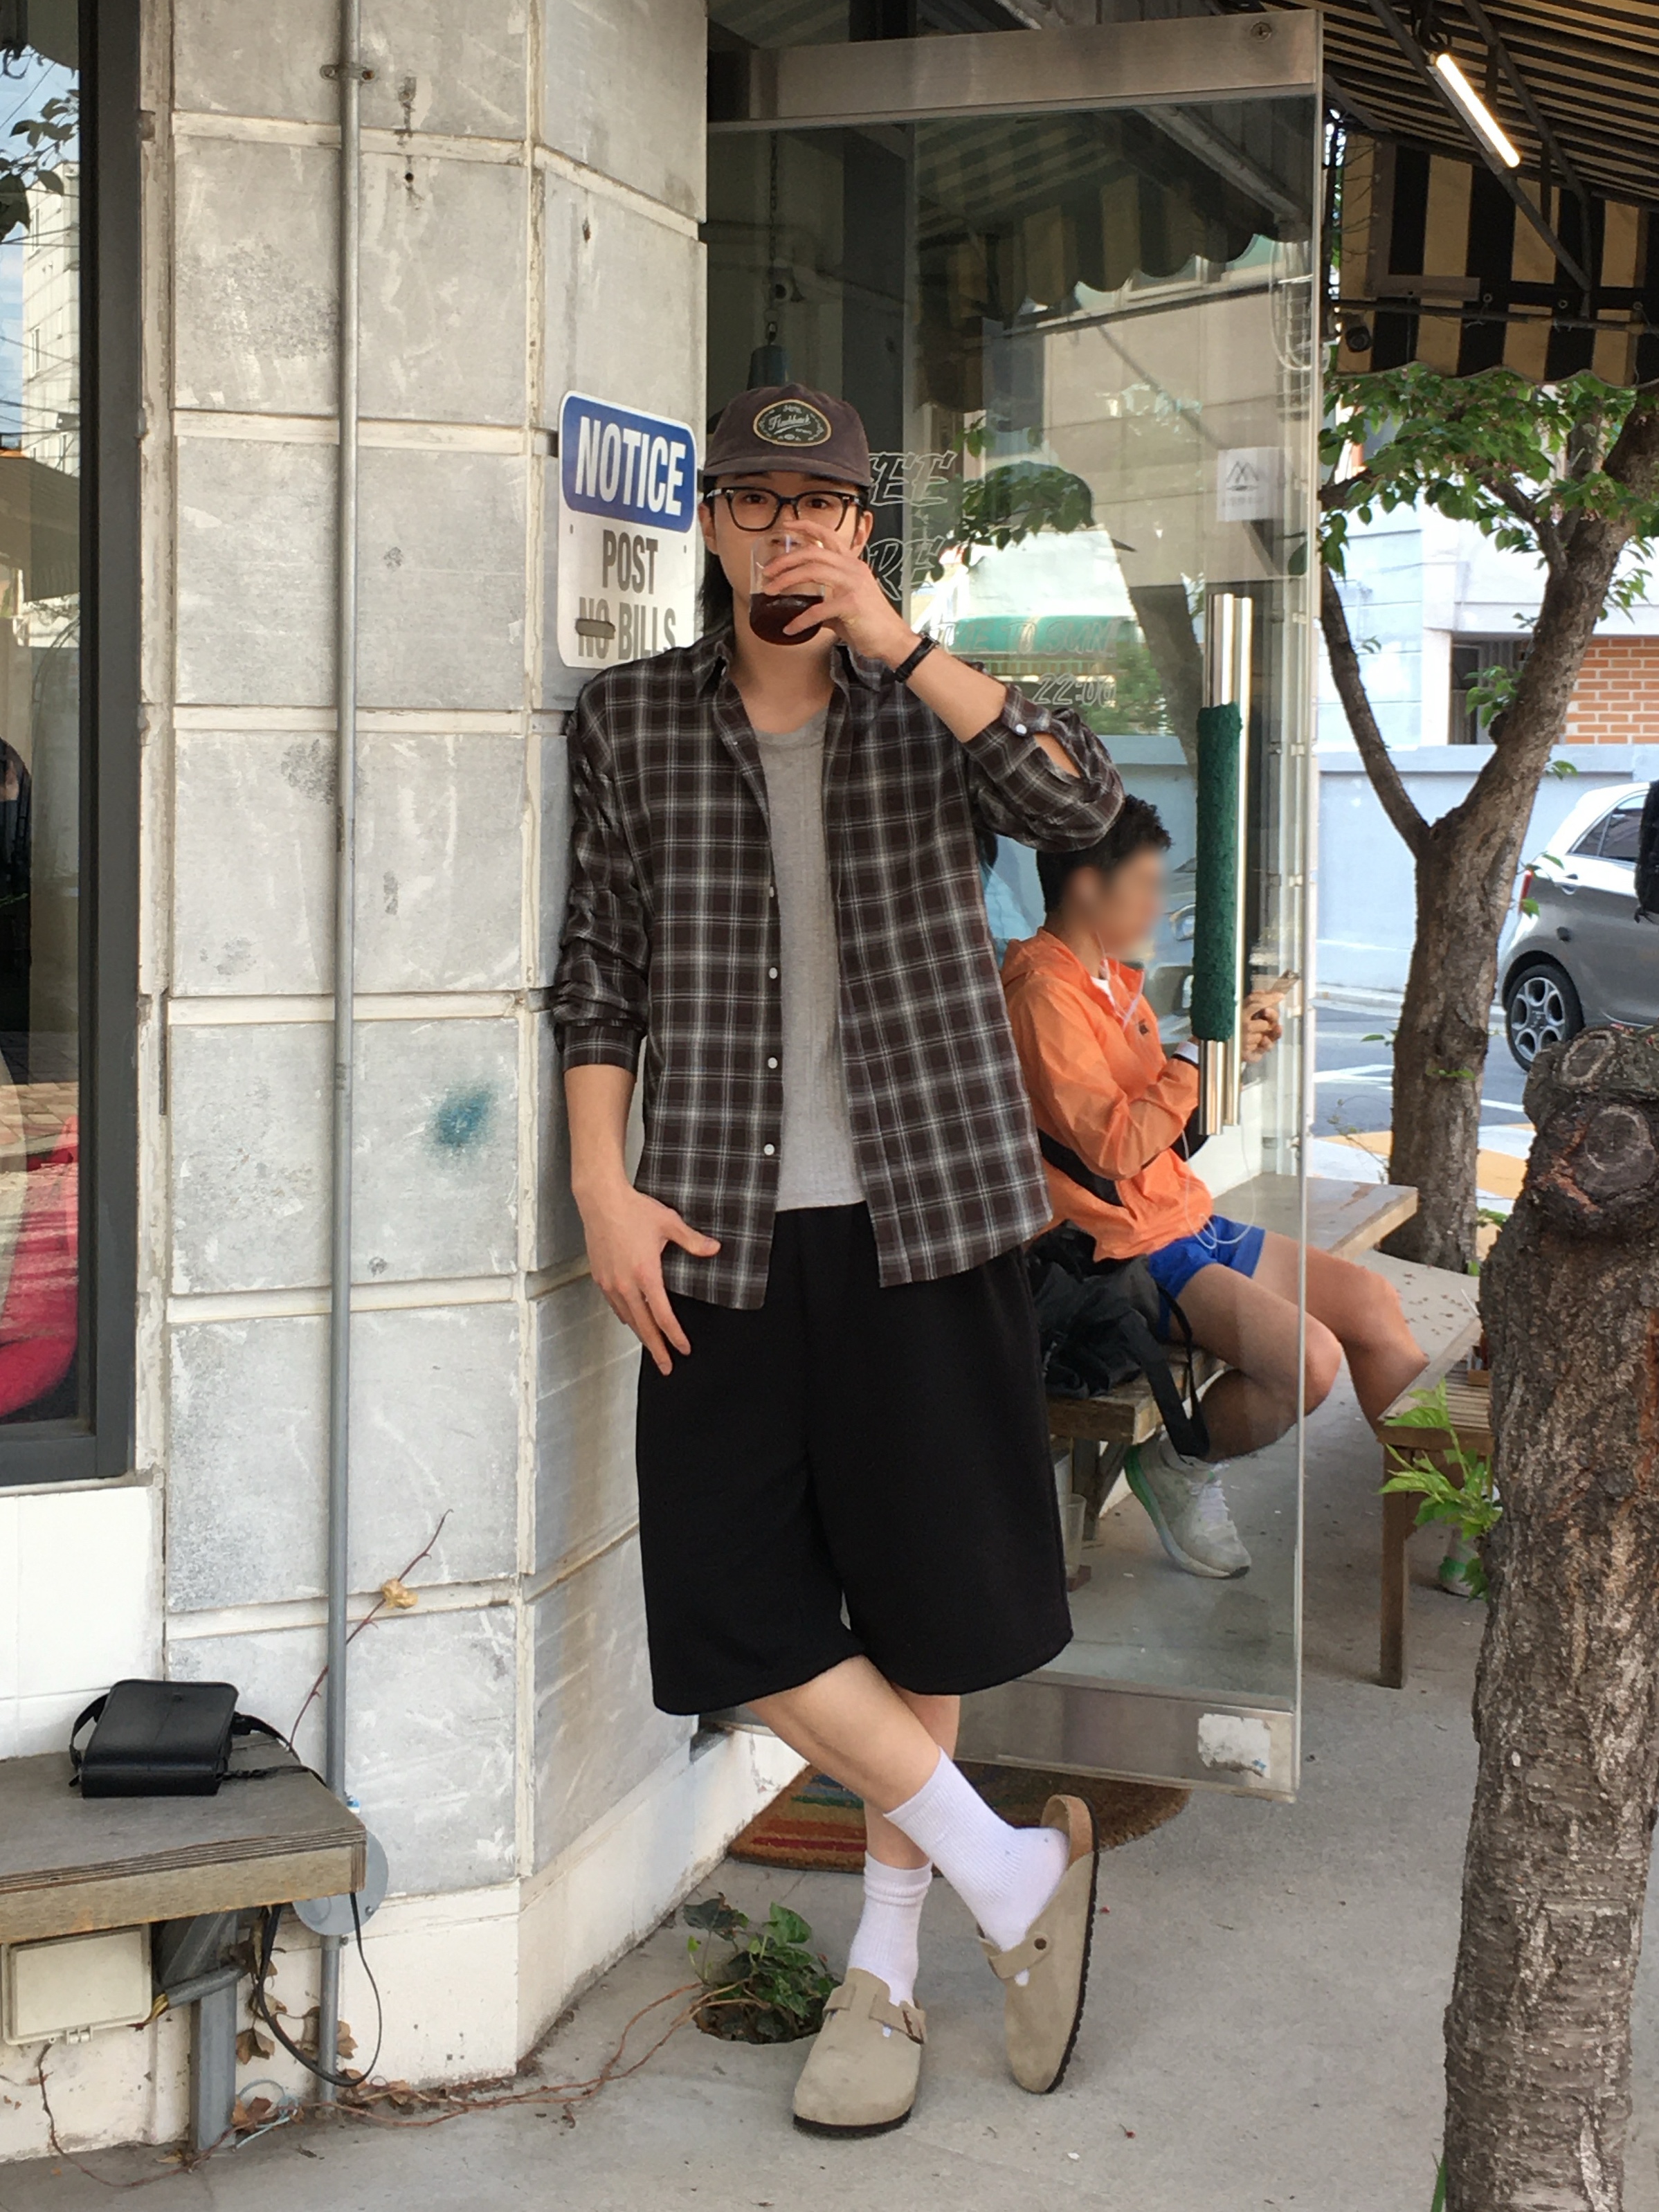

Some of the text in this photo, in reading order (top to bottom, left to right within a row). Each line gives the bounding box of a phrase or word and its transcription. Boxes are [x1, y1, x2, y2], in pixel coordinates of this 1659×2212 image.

[574, 415, 686, 516] NOTICE
[601, 529, 659, 595] POST
[862, 535, 946, 601] RE
[578, 597, 676, 660] NO BILLS
